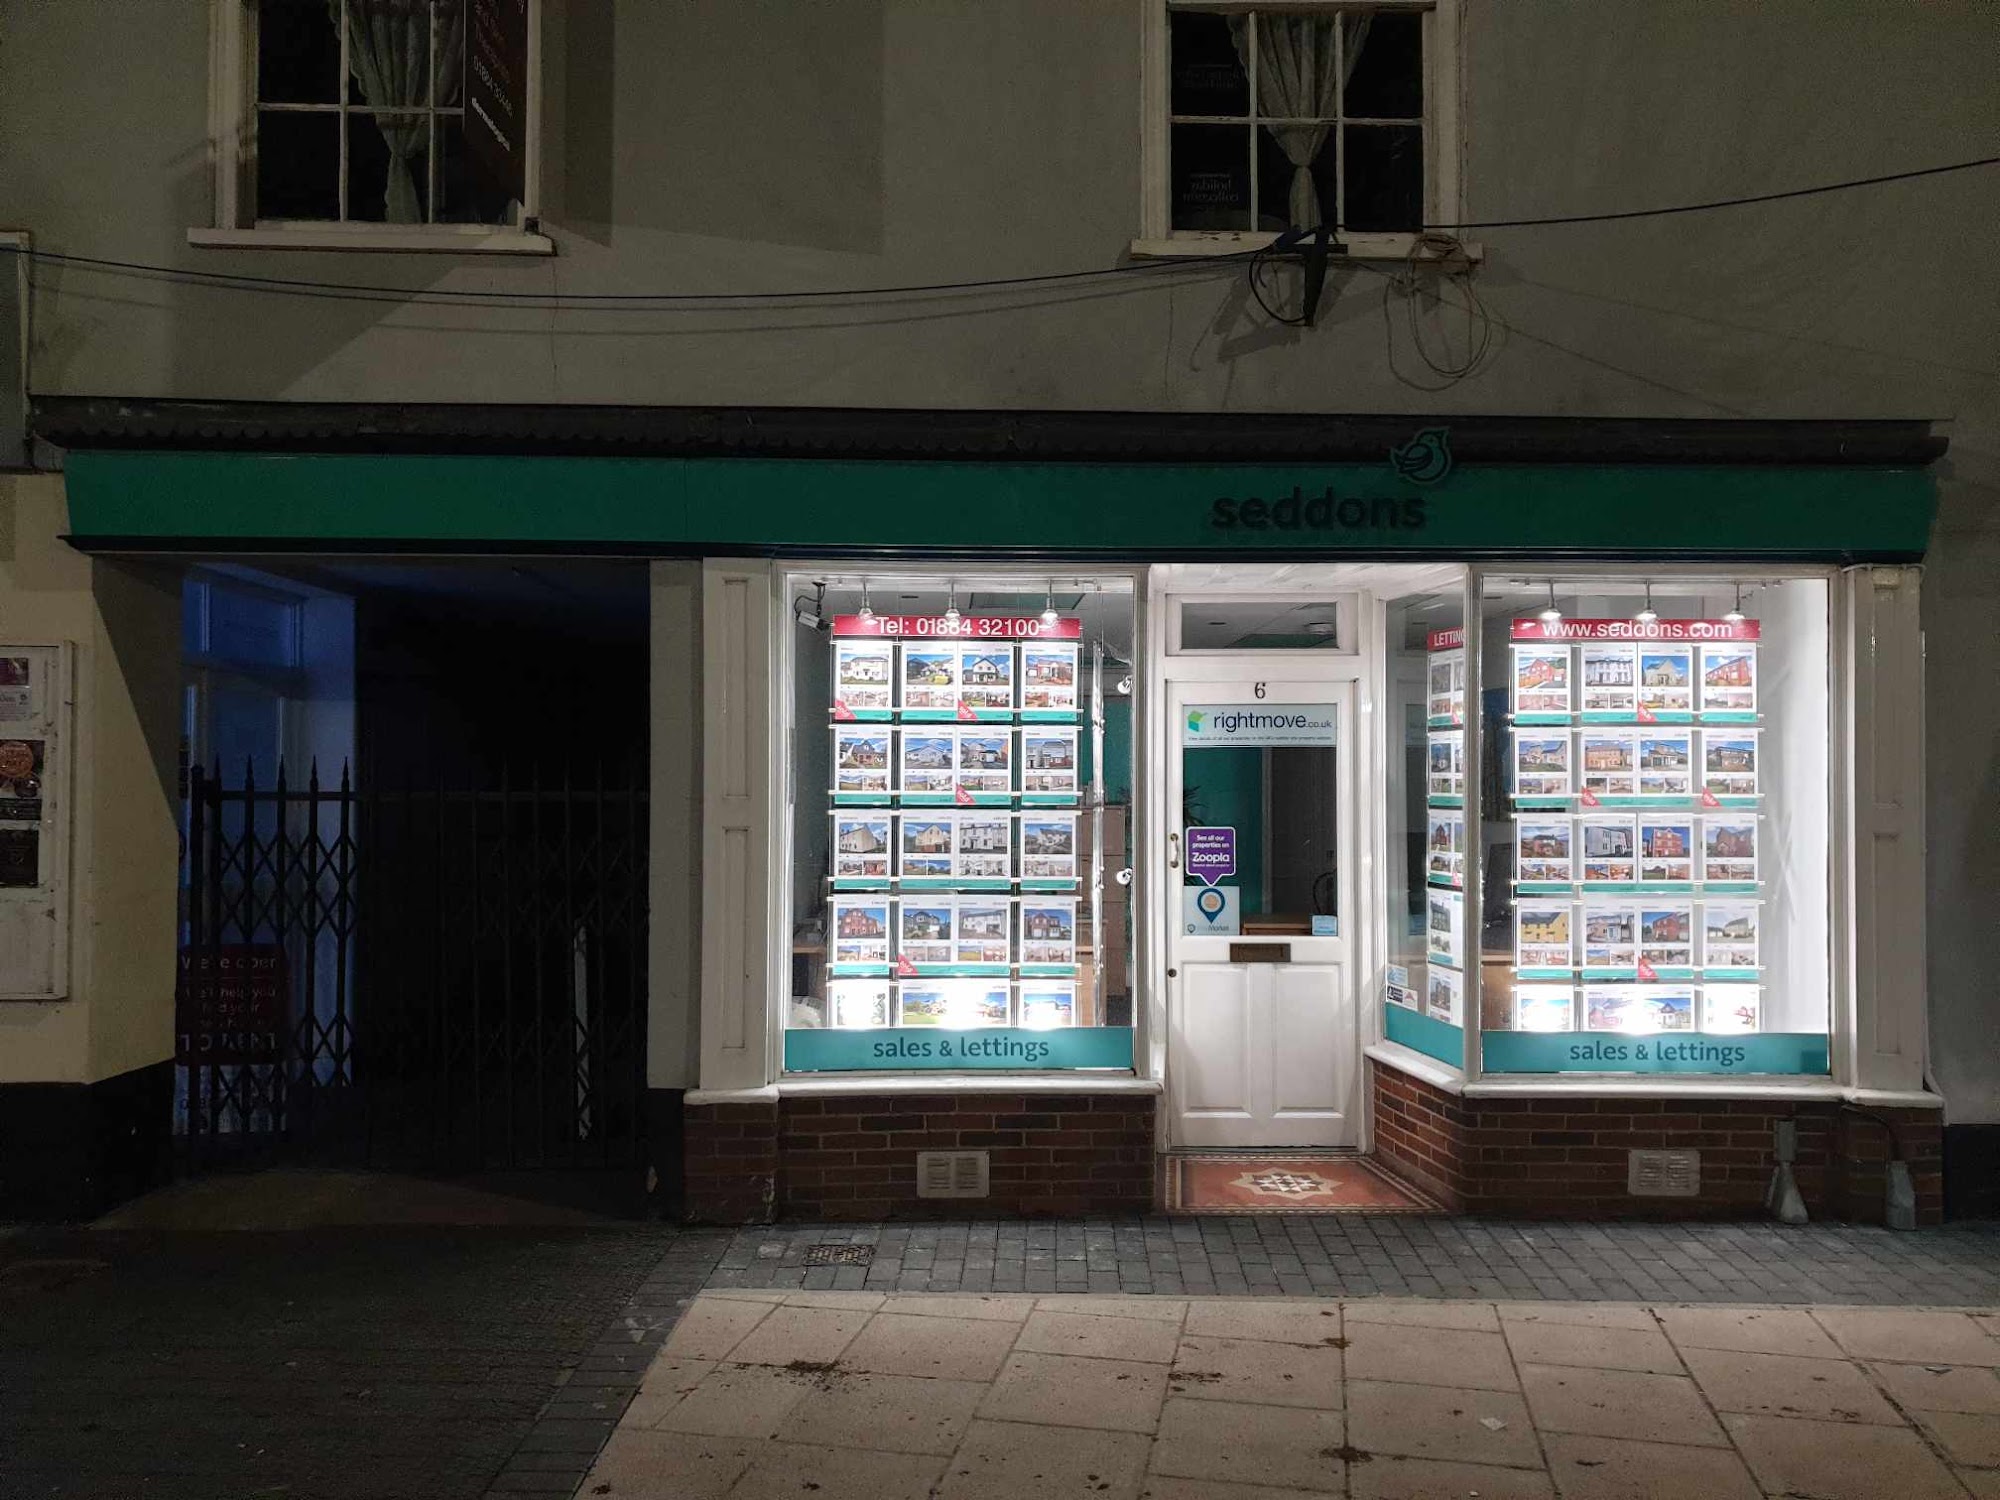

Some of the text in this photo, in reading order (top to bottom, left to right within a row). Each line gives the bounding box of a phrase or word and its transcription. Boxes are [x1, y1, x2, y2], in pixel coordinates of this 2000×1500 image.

[1211, 486, 1426, 530] seddons
[876, 616, 1040, 636] Tel: 01884 32100
[1541, 620, 1733, 638] www.seddons.com
[1254, 682, 1266, 699] 6
[1191, 852, 1230, 863] Zoopla
[873, 1037, 1050, 1062] sales & lettings
[1570, 1040, 1746, 1067] sales & lettings
